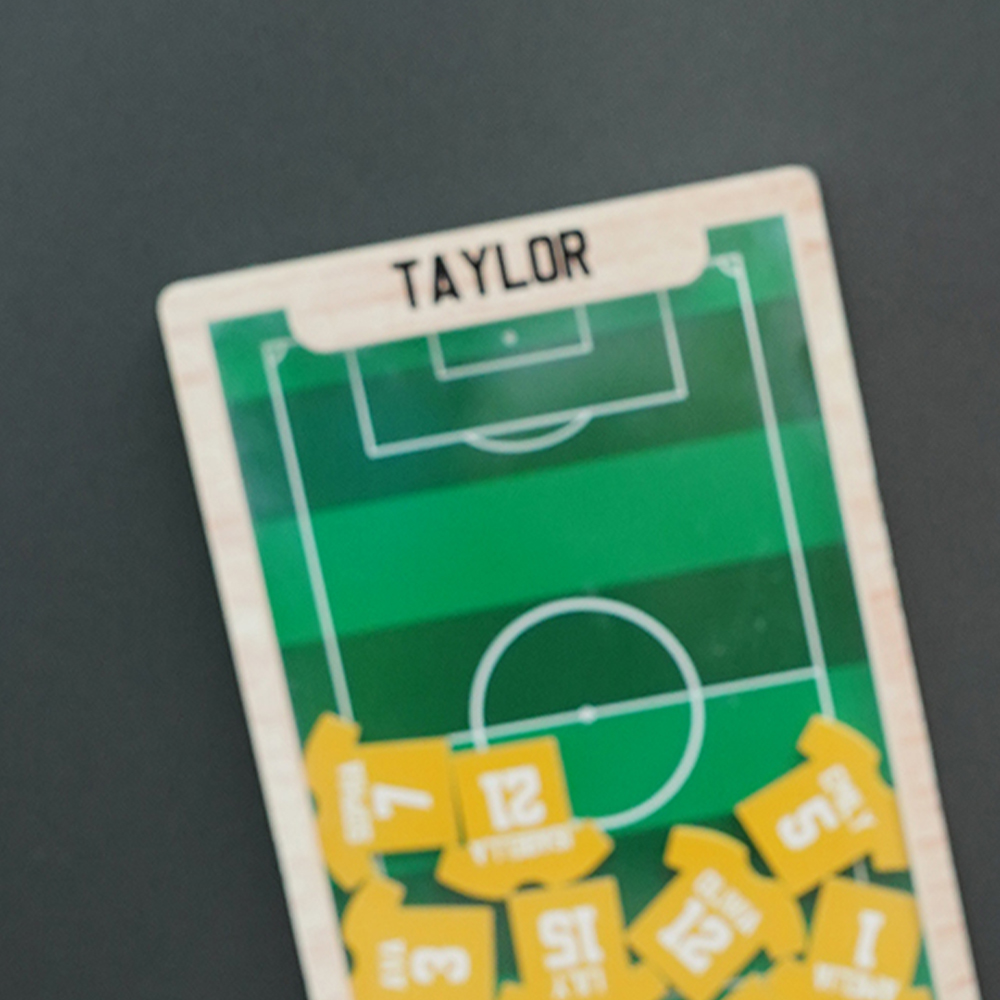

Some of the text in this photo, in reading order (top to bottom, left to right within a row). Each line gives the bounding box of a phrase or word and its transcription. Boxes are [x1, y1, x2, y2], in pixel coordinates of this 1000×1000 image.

[392, 229, 591, 308] TAYLOR
[372, 782, 434, 821] 7
[775, 794, 839, 852] 5
[409, 945, 471, 986] 3
[536, 904, 606, 970] 15
[656, 896, 734, 977] 12
[853, 908, 886, 970] 1
